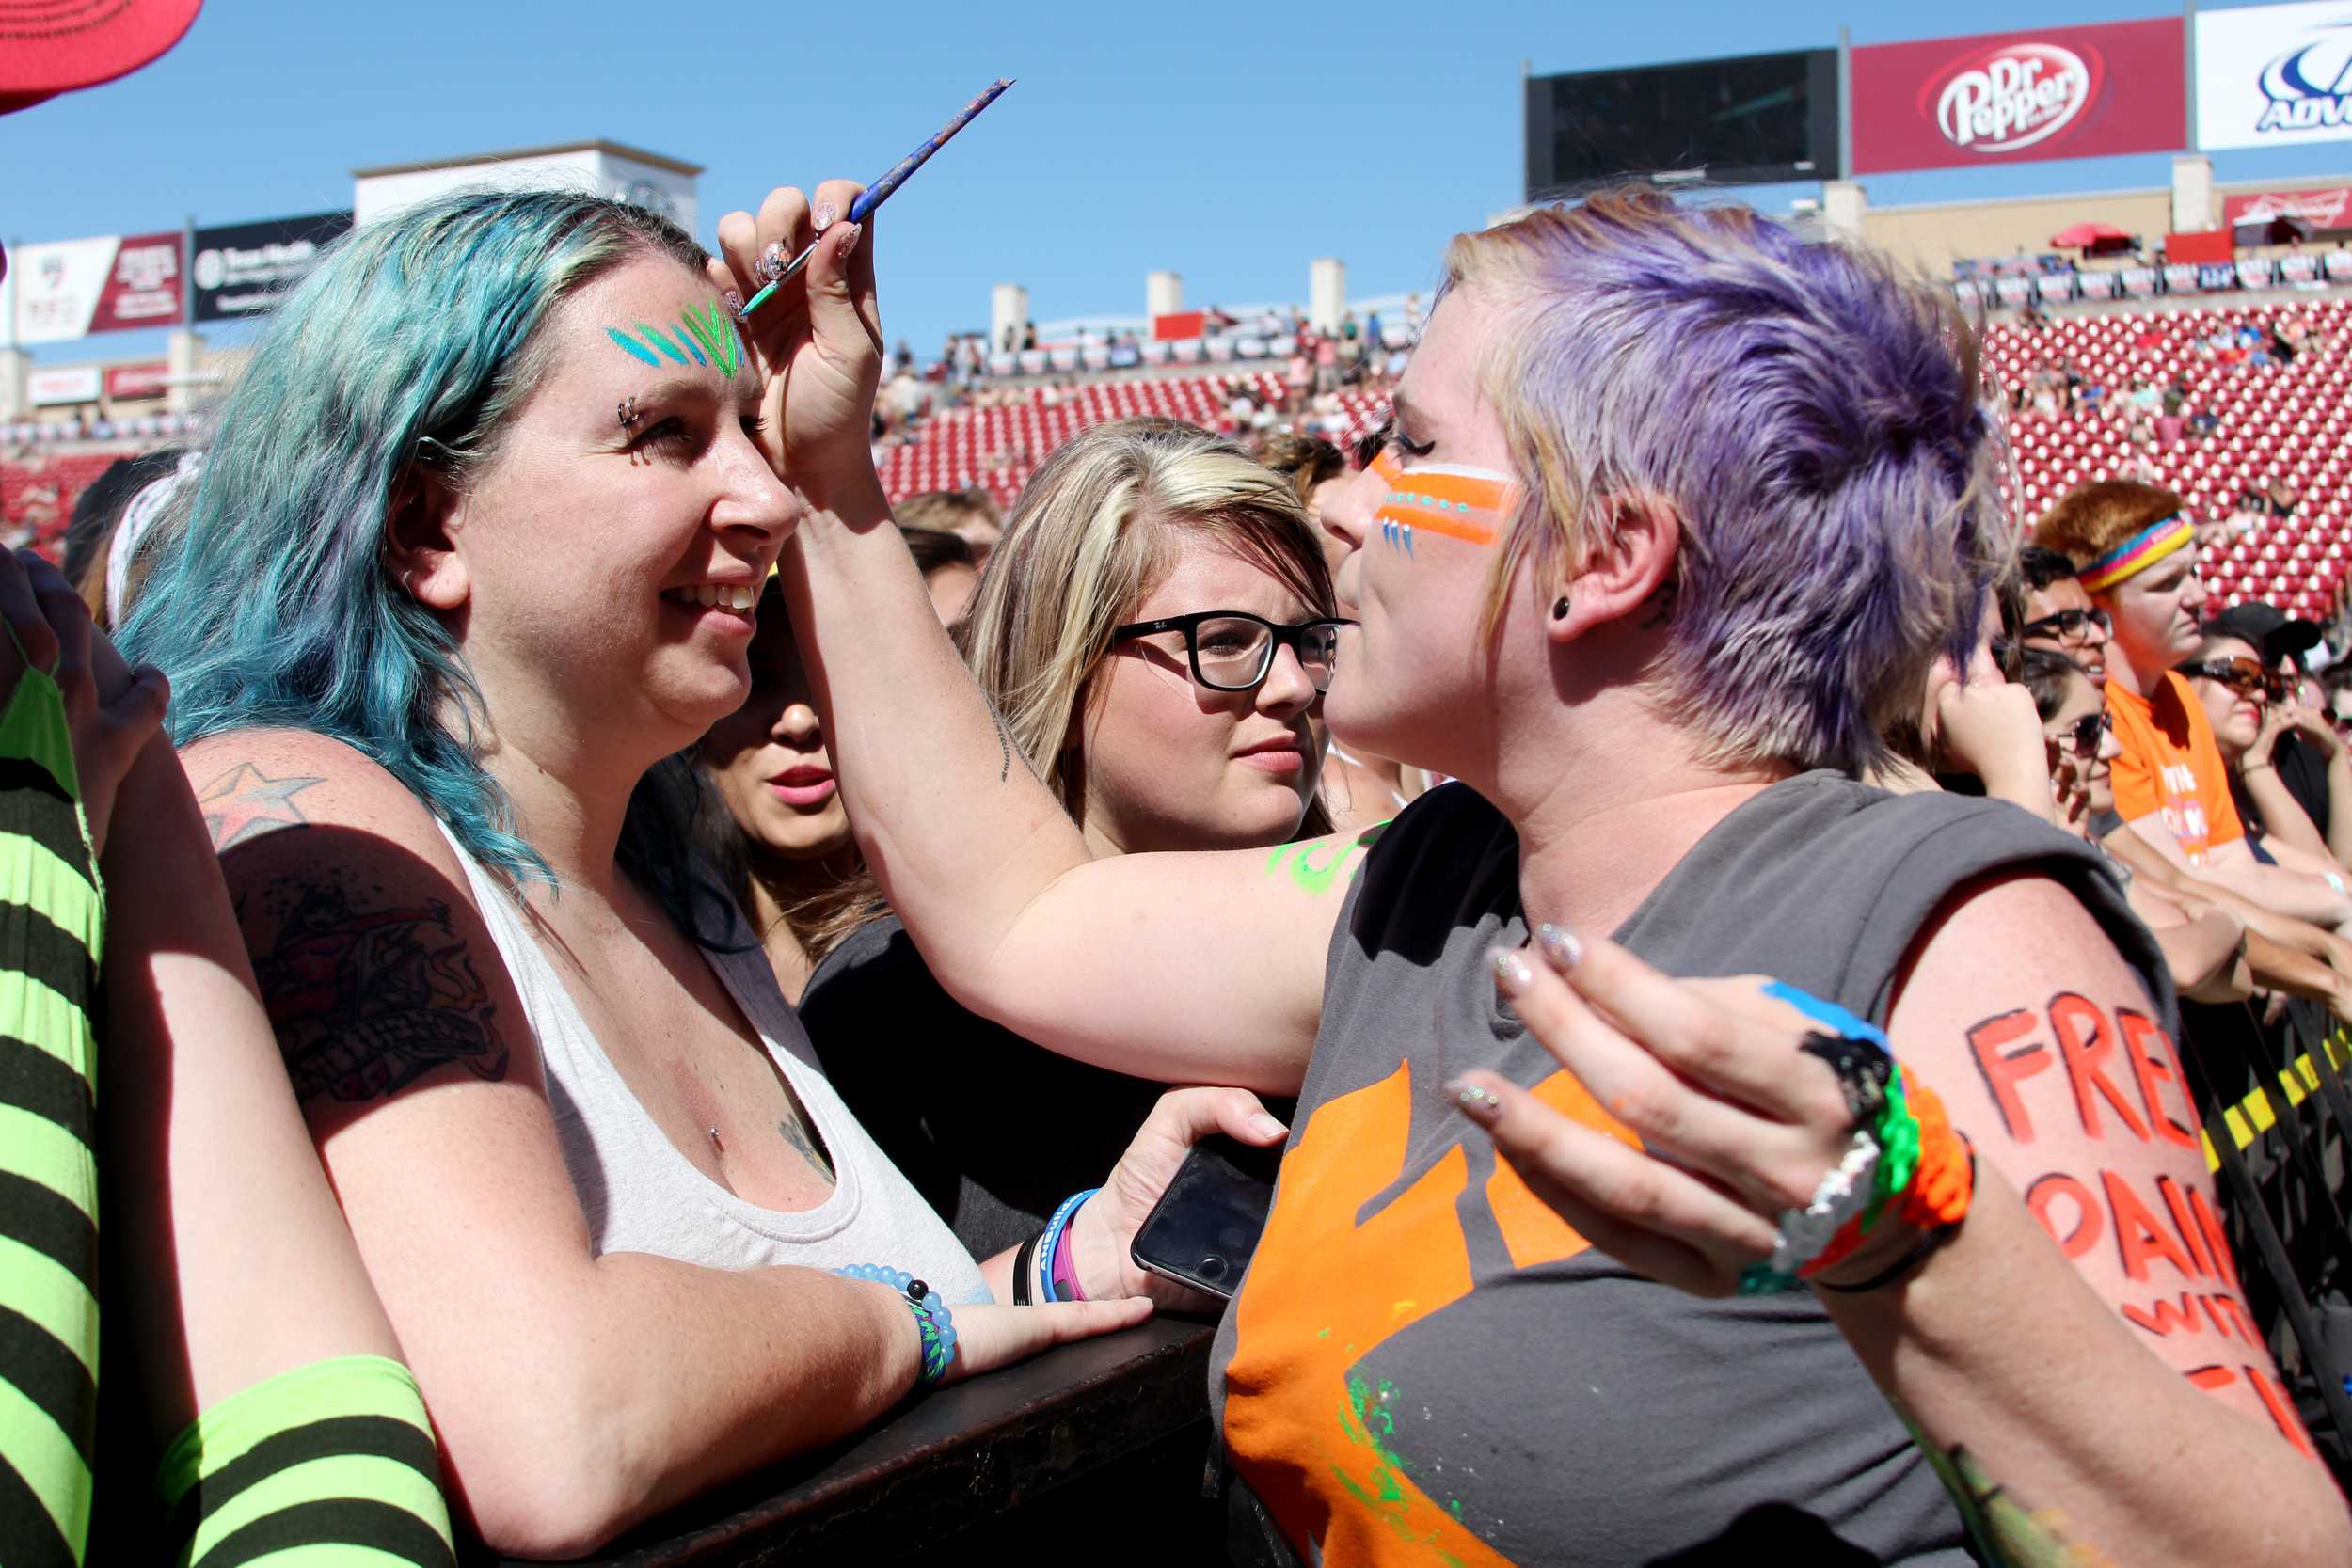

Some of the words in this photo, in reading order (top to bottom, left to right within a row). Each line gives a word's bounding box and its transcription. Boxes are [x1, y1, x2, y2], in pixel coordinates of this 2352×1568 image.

[1988, 57, 2043, 102] Dr
[1951, 70, 2076, 145] Pepper
[2256, 94, 2352, 133] ADV
